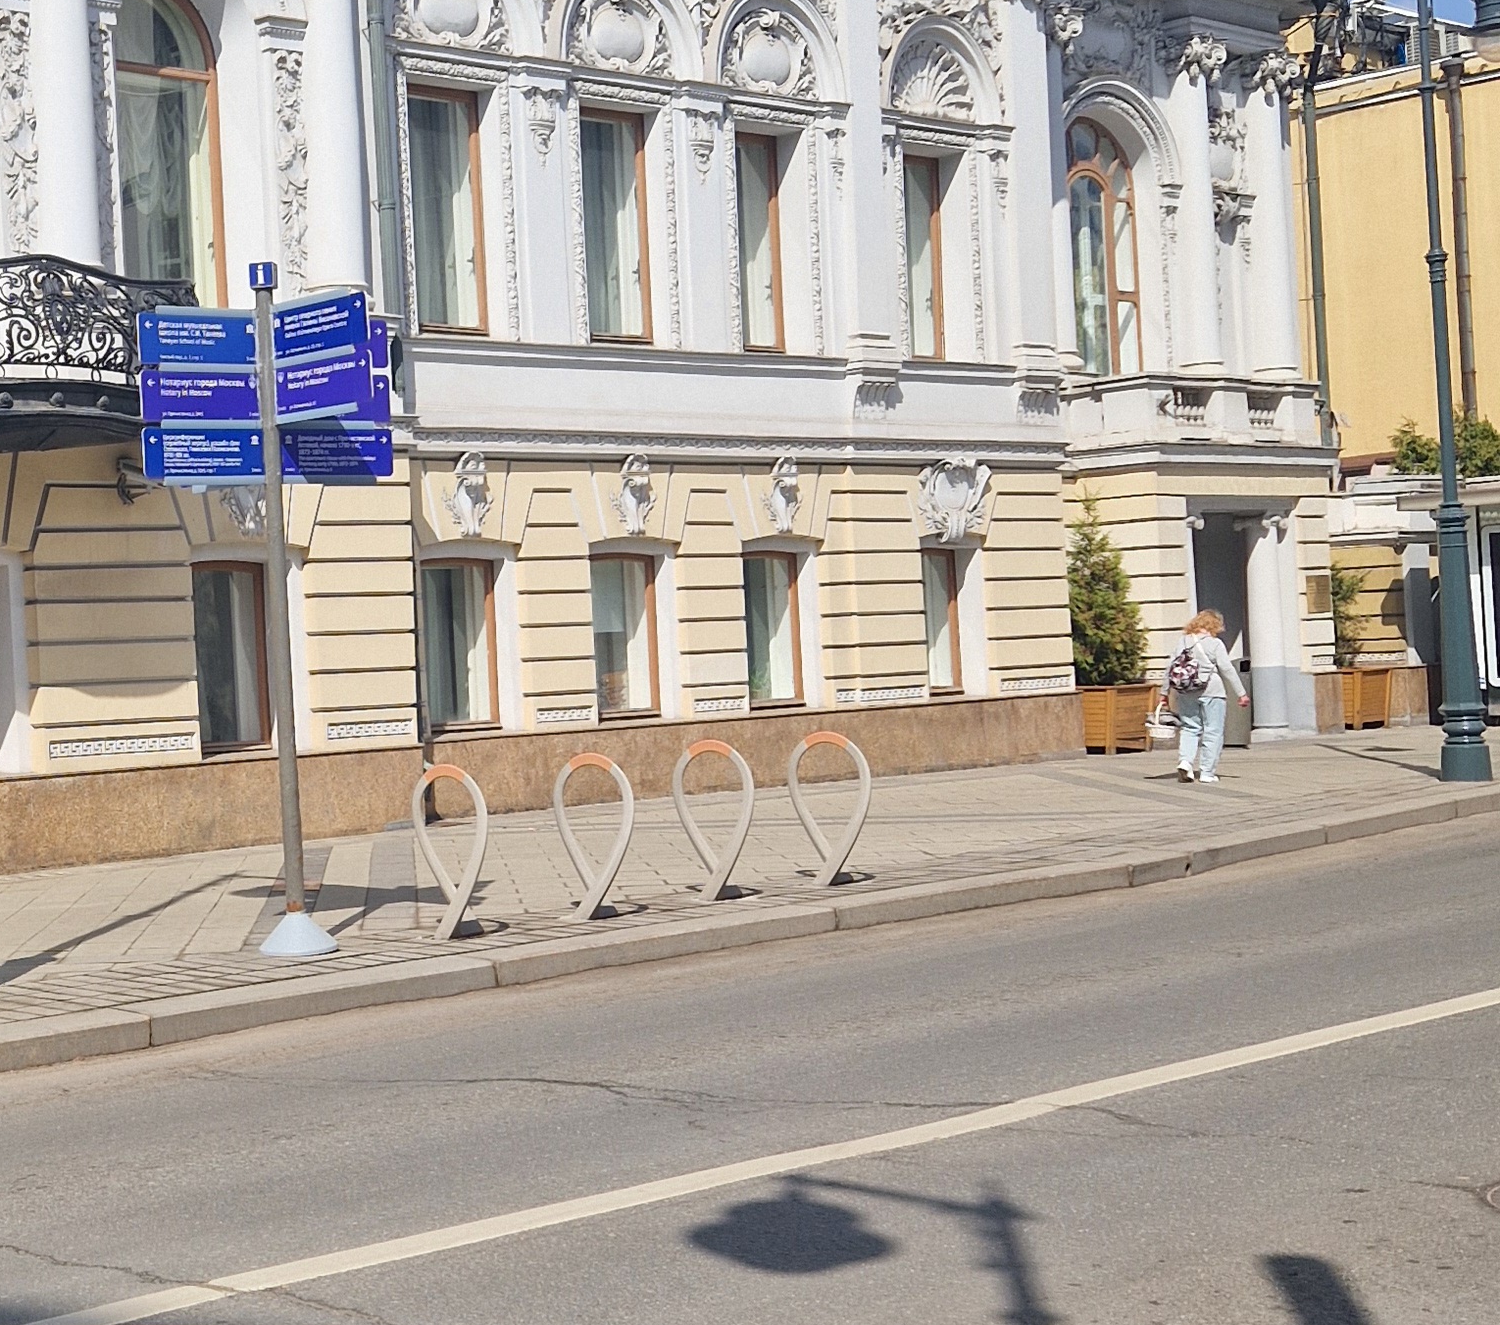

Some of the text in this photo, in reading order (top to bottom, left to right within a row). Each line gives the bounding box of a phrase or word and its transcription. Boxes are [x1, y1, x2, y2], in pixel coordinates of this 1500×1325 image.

[158, 320, 182, 329] Детская
[287, 368, 312, 380] Нотариус
[333, 360, 355, 371] Москвы
[160, 377, 245, 388] Нотариус города Москвы
[160, 388, 212, 398] Notary in Moscow
